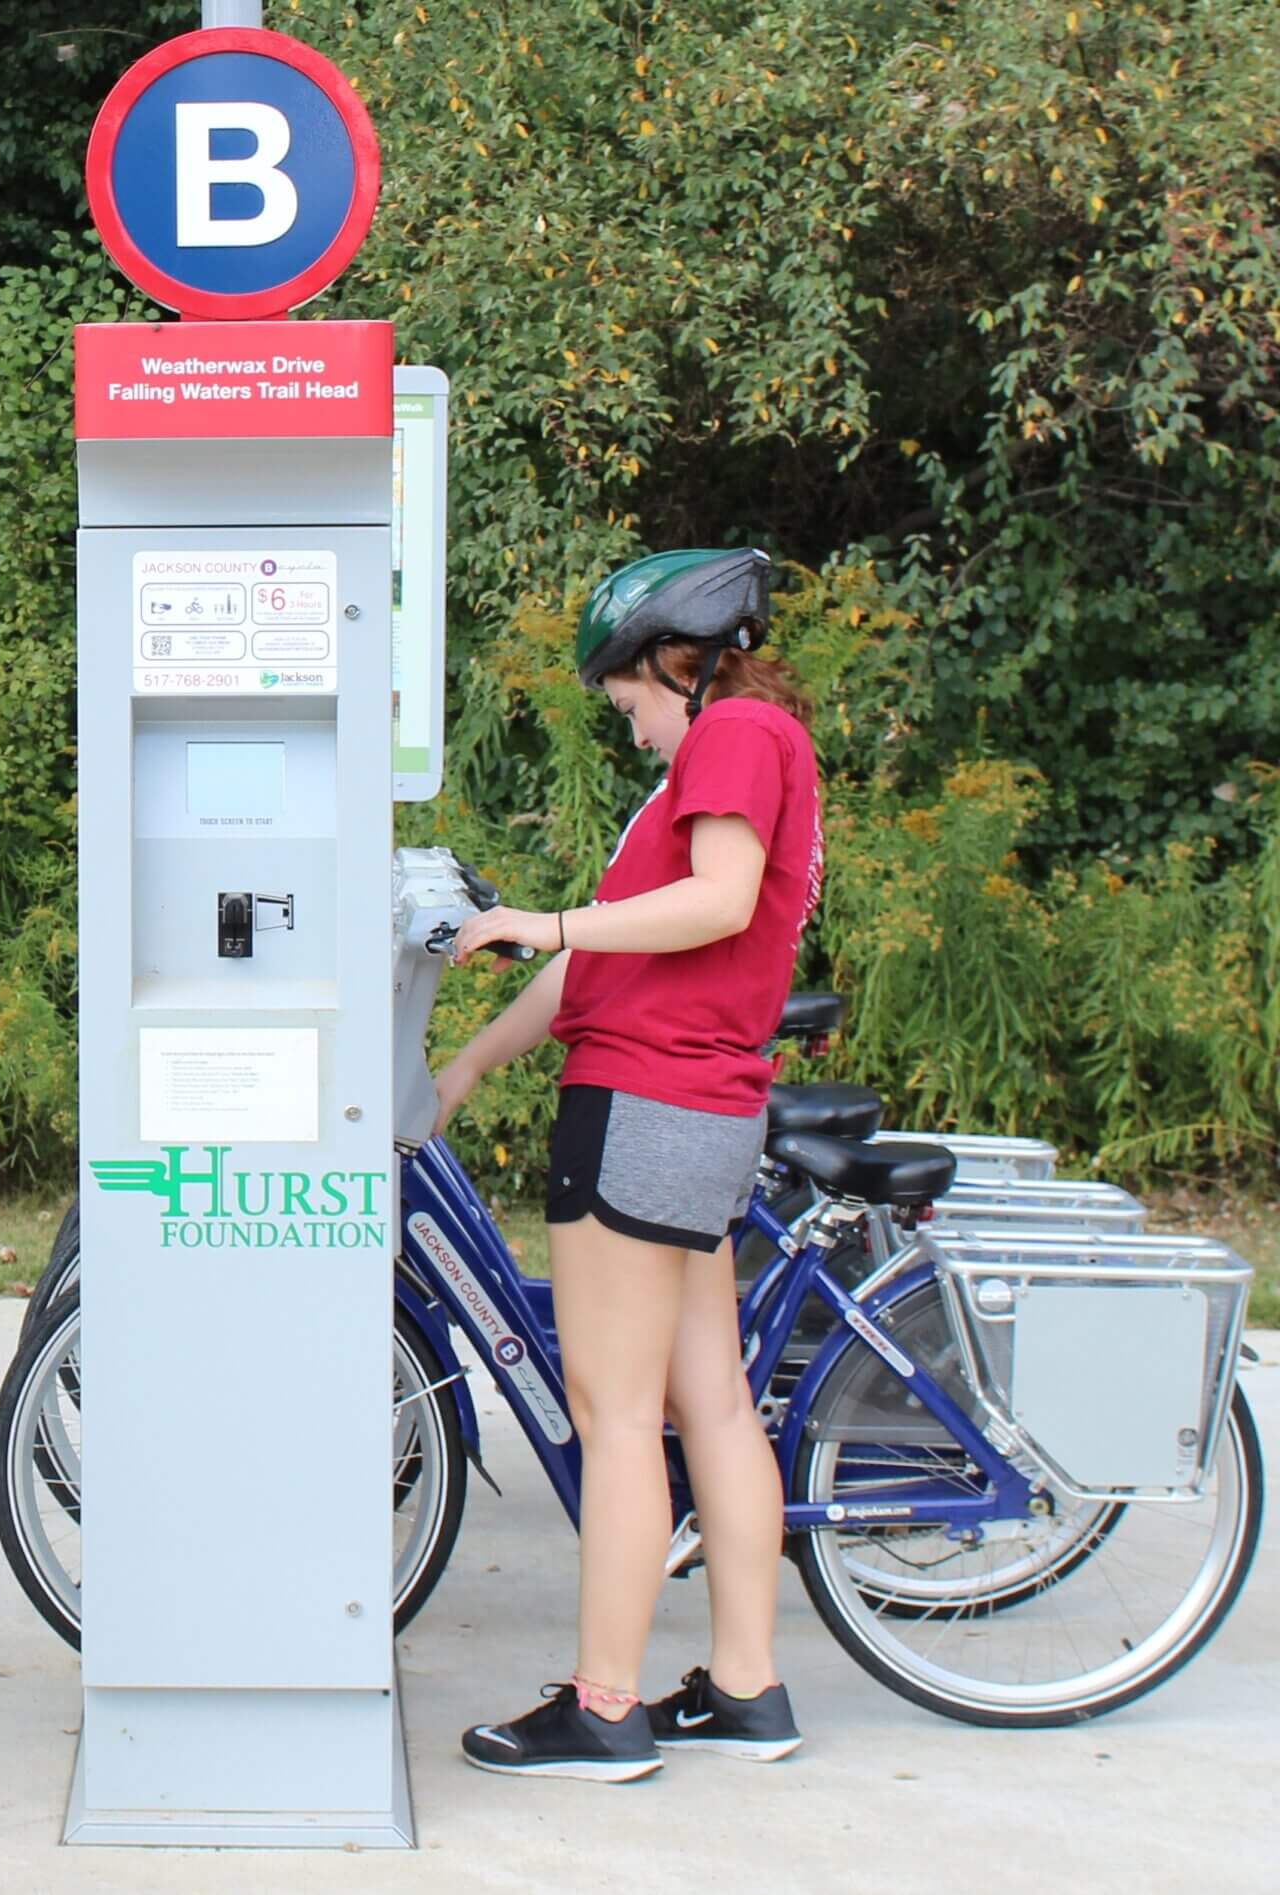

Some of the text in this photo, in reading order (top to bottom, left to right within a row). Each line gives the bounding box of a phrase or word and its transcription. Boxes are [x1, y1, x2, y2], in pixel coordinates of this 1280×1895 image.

[175, 102, 299, 248] B
[141, 356, 326, 375] Weatherwax Drive
[108, 381, 360, 404] Falling Waters Trail Head
[141, 562, 202, 574] JACKSON
[204, 561, 258, 574] COUNTY
[143, 673, 240, 688] 517-768-2901
[280, 671, 324, 684] Jackson
[160, 1146, 387, 1217] HURST
[160, 1221, 387, 1248] FOUNDATION
[414, 1220, 463, 1281] JACKSON
[460, 1281, 504, 1337] COUNTY
